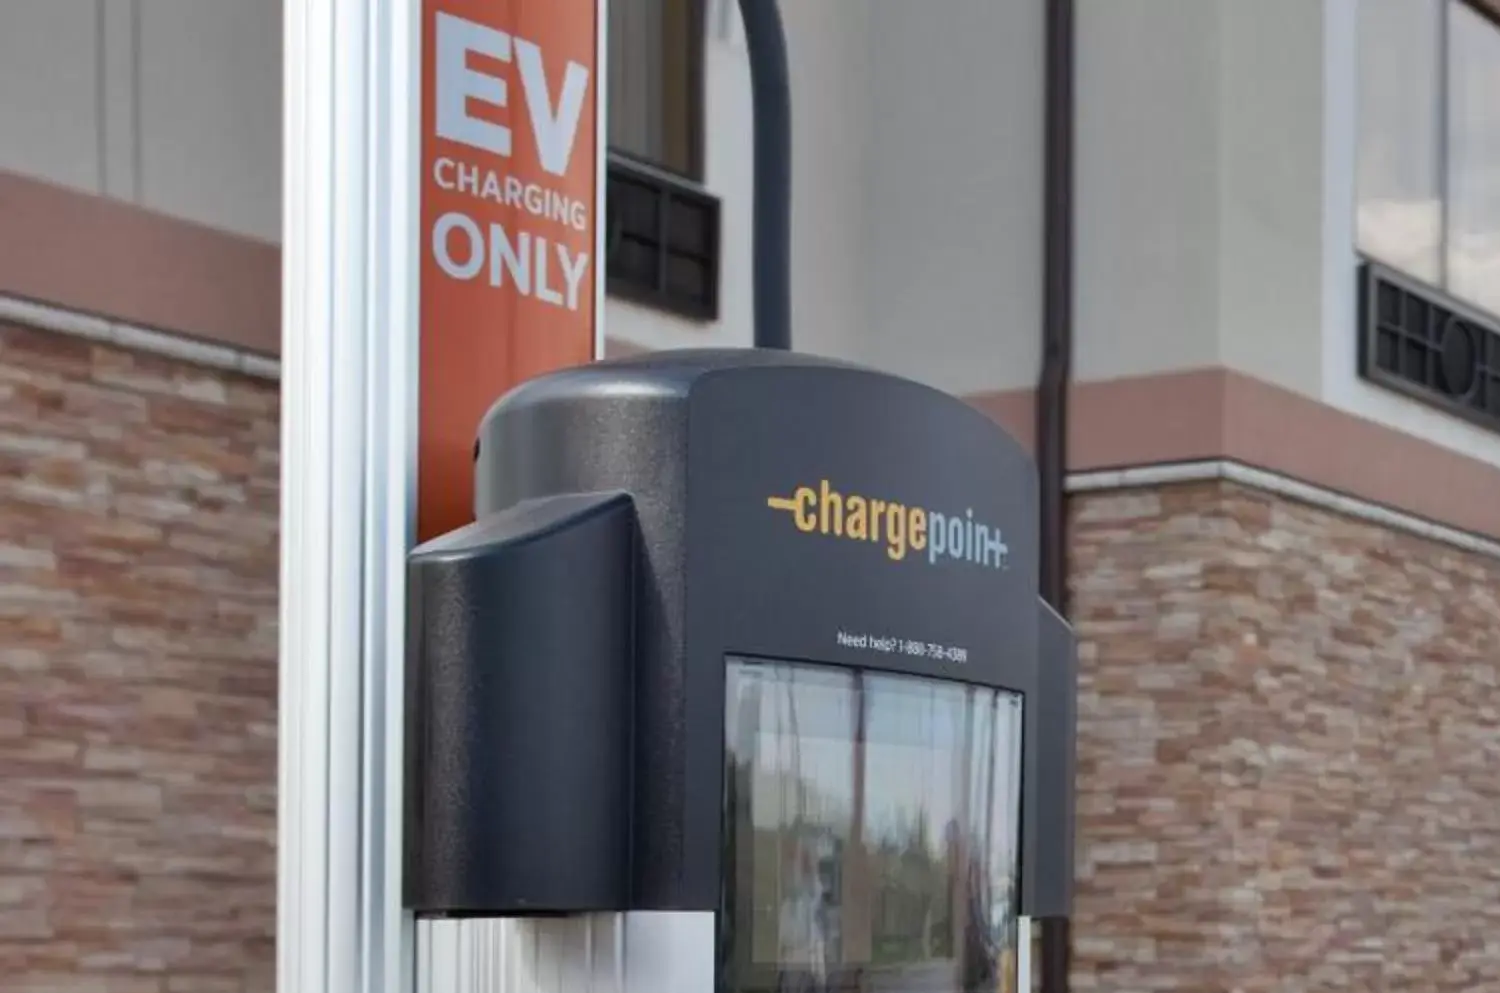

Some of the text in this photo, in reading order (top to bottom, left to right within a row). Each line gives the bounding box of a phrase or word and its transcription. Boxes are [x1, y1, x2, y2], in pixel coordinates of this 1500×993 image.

[435, 10, 589, 177] EV
[433, 157, 586, 231] CHARGING
[432, 211, 588, 311] ONLY
[837, 631, 867, 648] Need
[869, 634, 897, 653] help?
